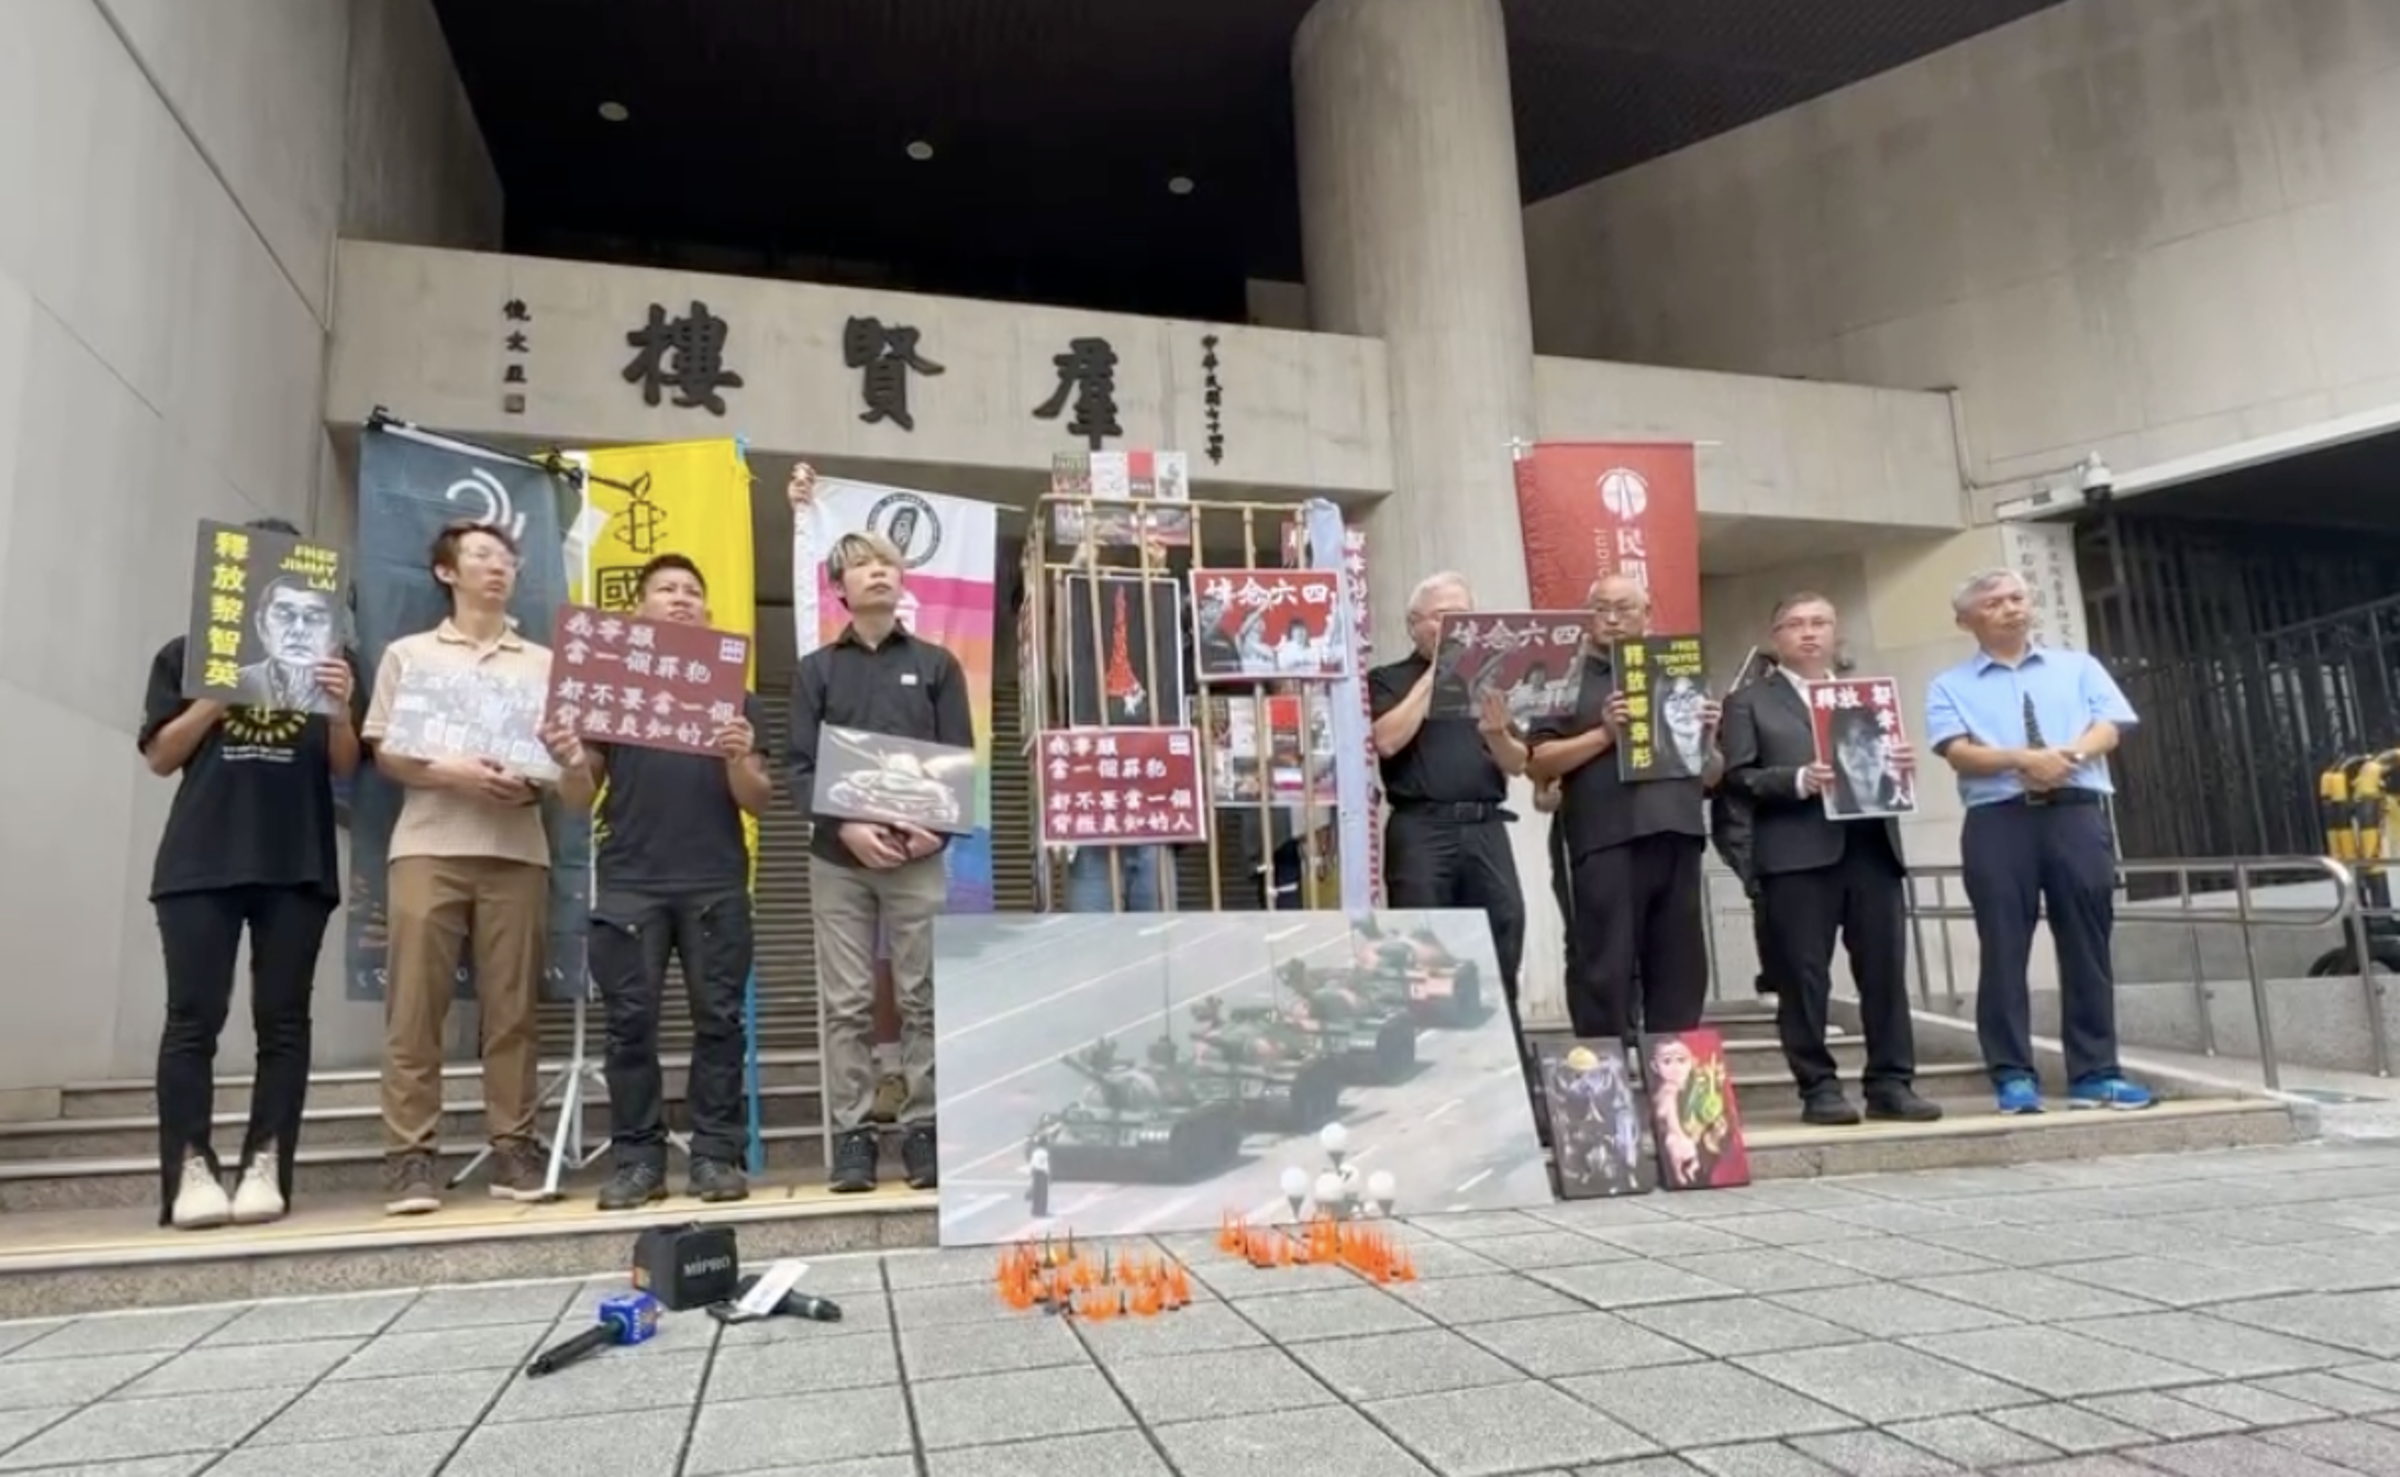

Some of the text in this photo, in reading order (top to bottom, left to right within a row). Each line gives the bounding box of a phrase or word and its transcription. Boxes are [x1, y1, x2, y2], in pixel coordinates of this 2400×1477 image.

[294, 545, 337, 562] FREE
[279, 557, 337, 577] JIMMY
[307, 577, 336, 592] LAI
[204, 531, 249, 689] 釋放黎智英
[1449, 618, 1582, 649] 悼念六四
